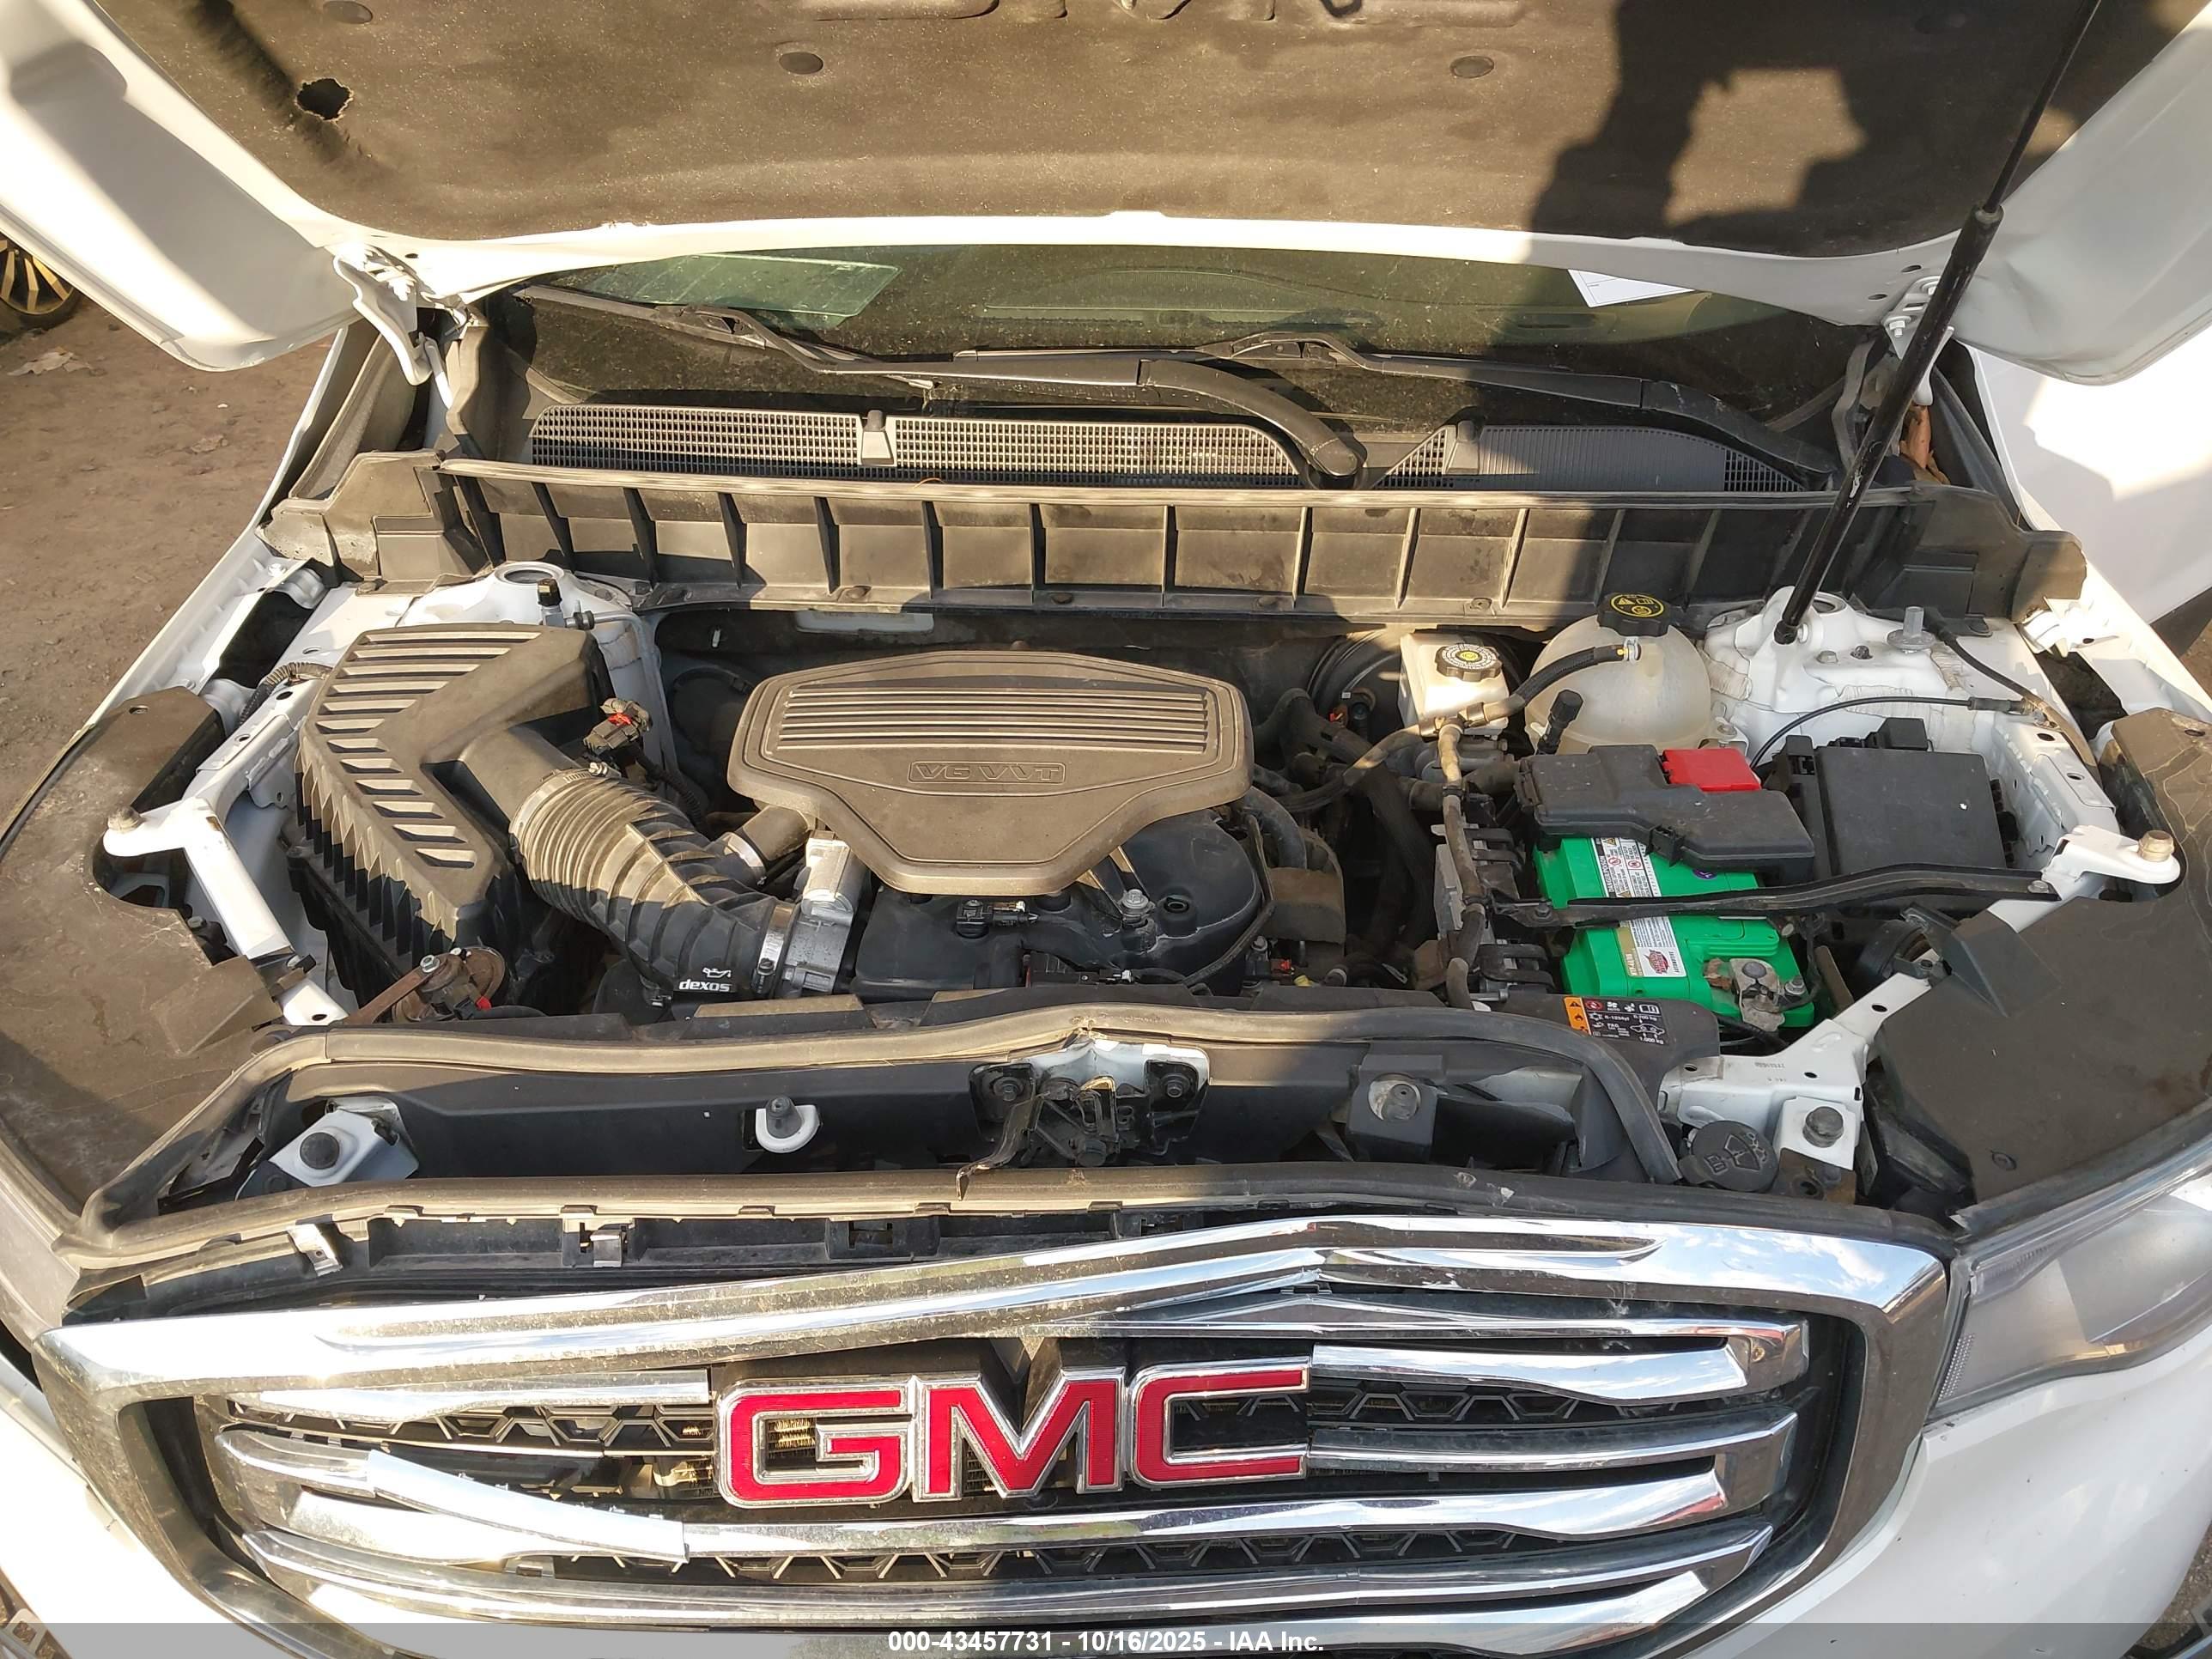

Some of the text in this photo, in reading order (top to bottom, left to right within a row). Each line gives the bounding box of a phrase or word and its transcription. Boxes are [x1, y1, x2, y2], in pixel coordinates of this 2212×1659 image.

[915, 764, 1060, 781] V6 VVT
[679, 978, 732, 993] dexos
[716, 1357, 1310, 1510] GMC
